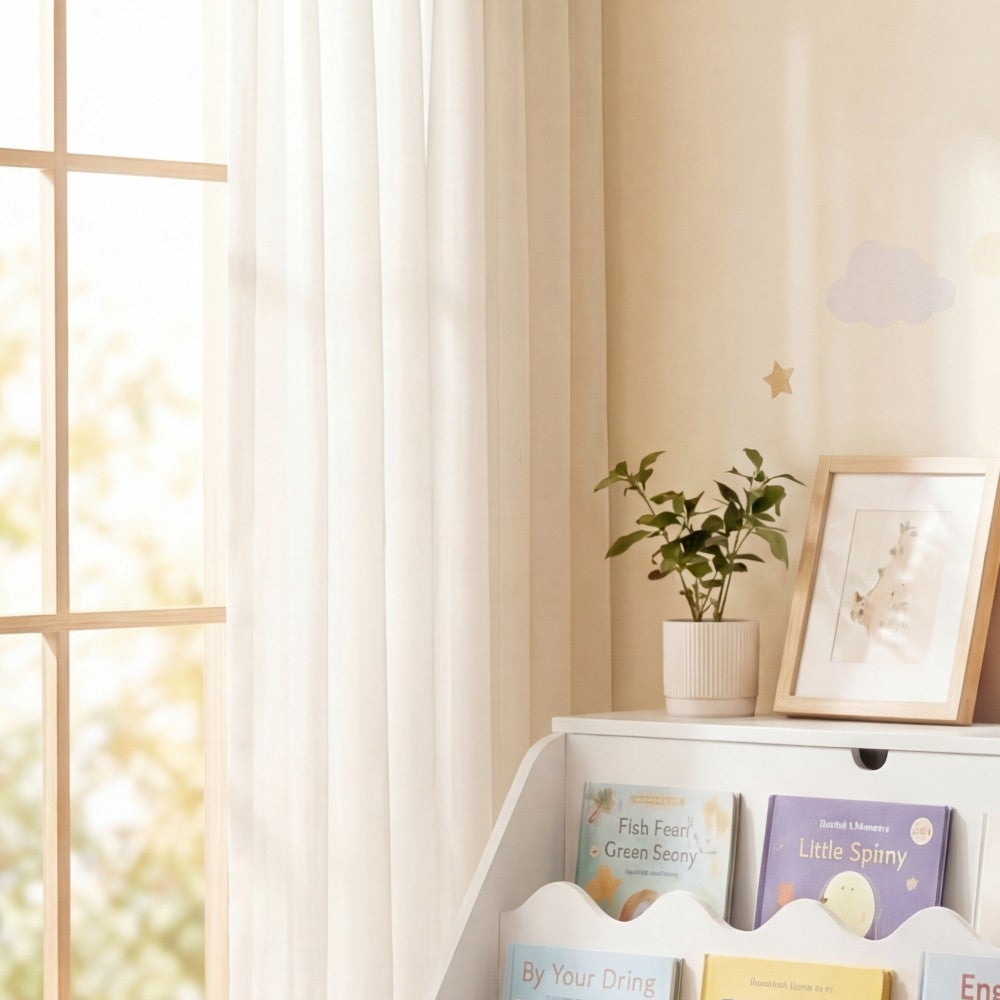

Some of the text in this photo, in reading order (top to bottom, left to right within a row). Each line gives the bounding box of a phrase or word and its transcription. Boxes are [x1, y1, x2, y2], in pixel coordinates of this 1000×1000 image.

[618, 817, 649, 836] Fish
[604, 841, 698, 870] Green Seony
[799, 837, 843, 861] Little
[522, 961, 656, 998] By Your Dring
